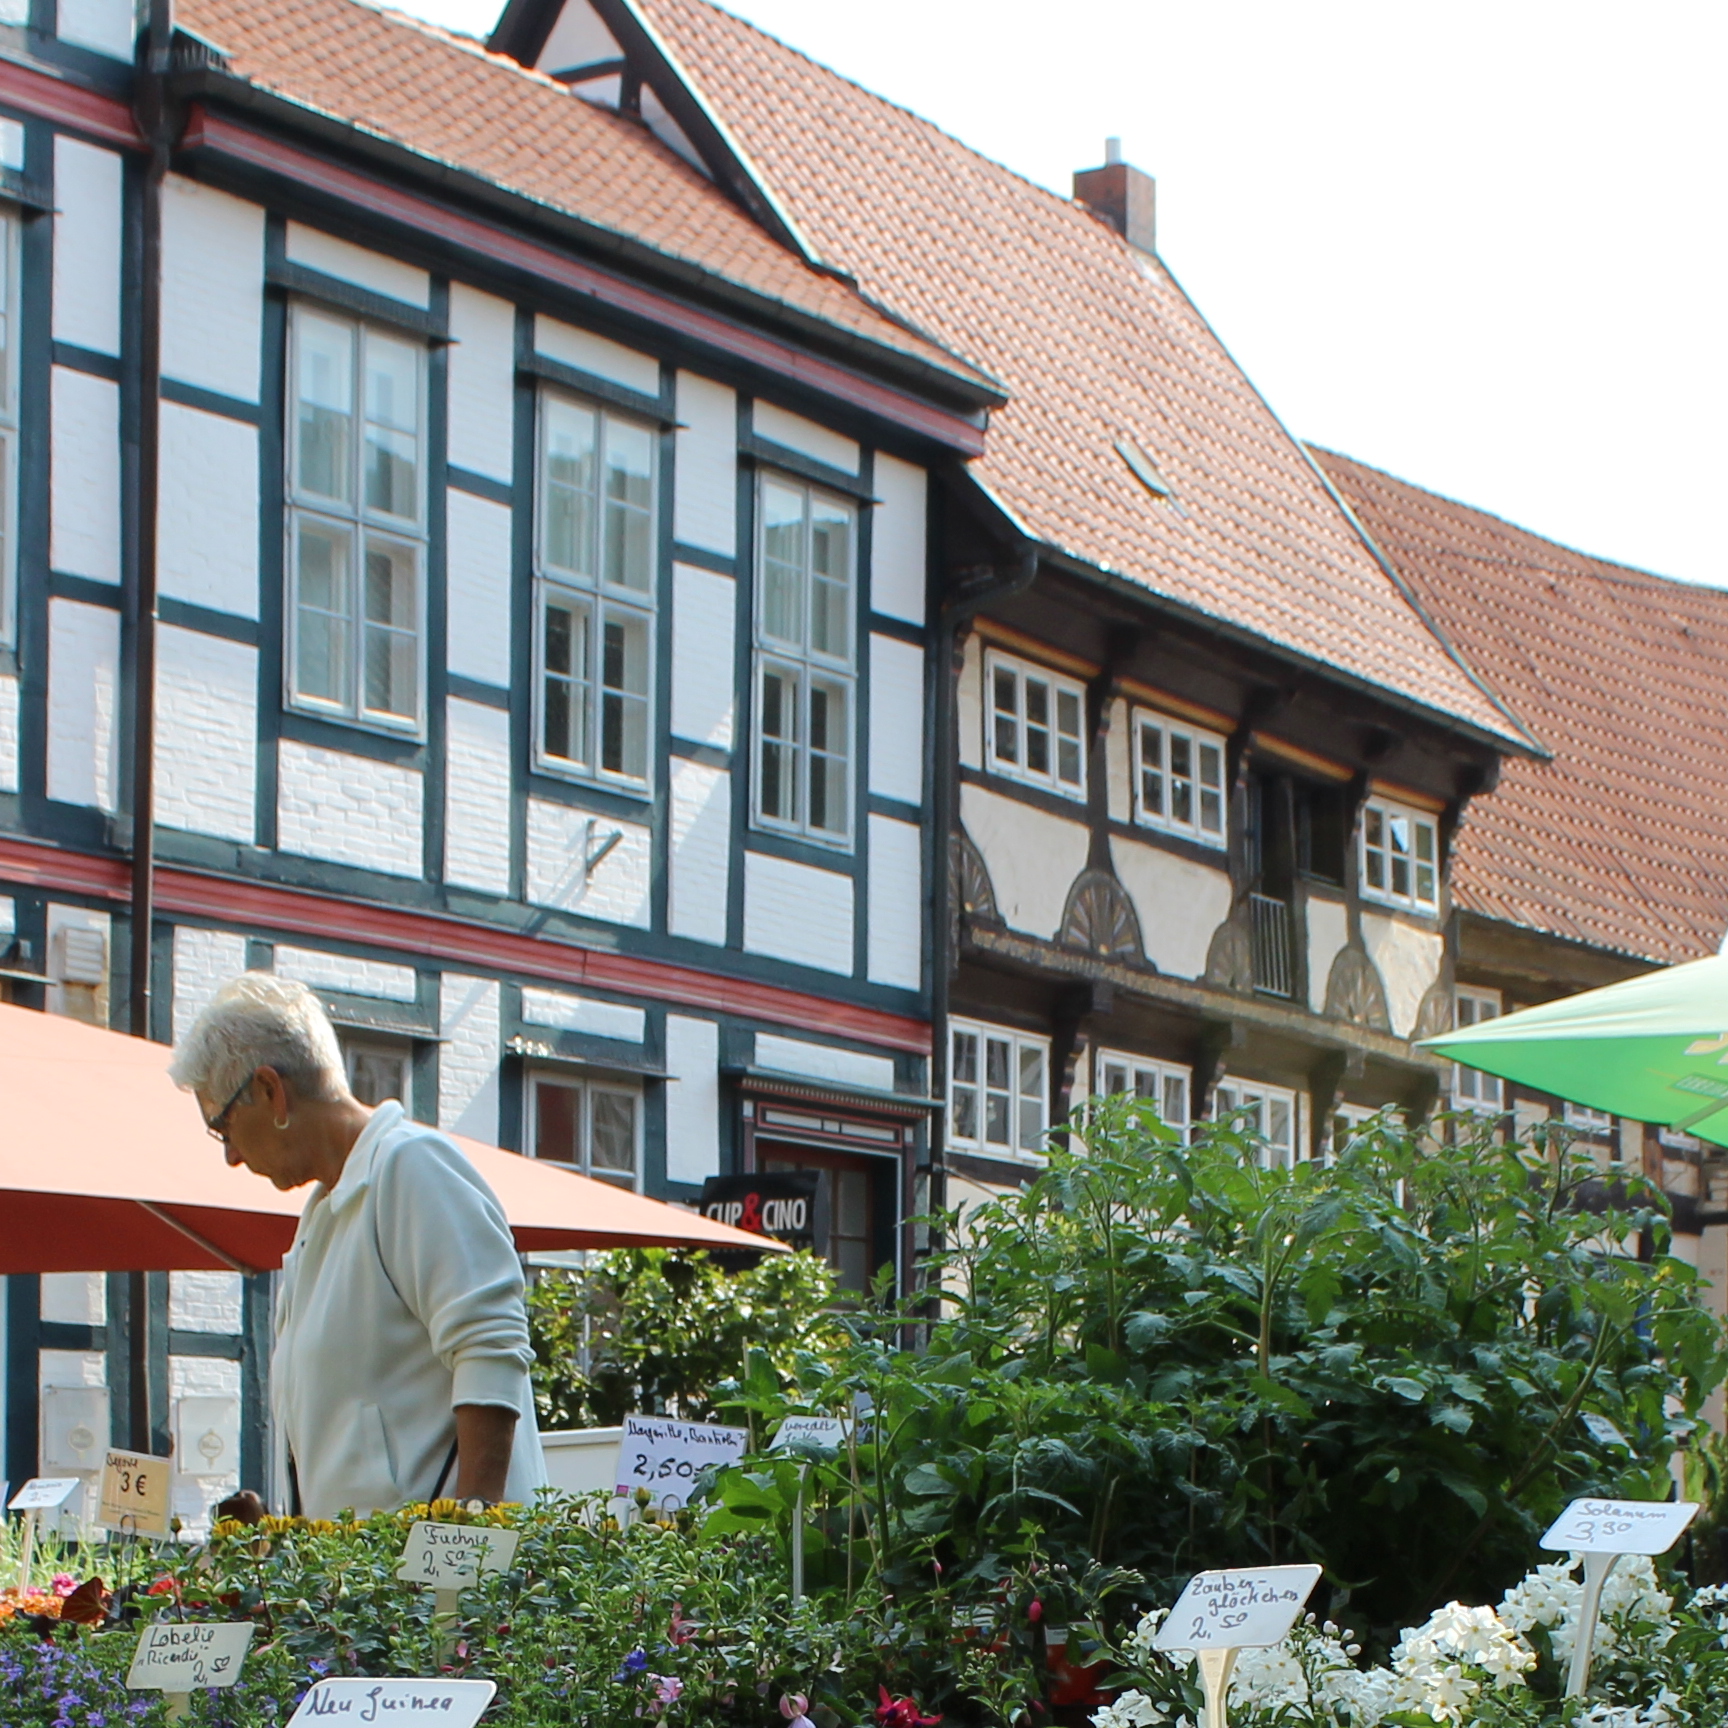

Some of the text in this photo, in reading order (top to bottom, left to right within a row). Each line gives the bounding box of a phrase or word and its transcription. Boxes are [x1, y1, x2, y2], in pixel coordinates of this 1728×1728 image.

[121, 1471, 147, 1496] 3 €
[1577, 1502, 1667, 1519] Solanum
[149, 1625, 215, 1648] Lobelie
[305, 1686, 454, 1722] Neu Guinea
